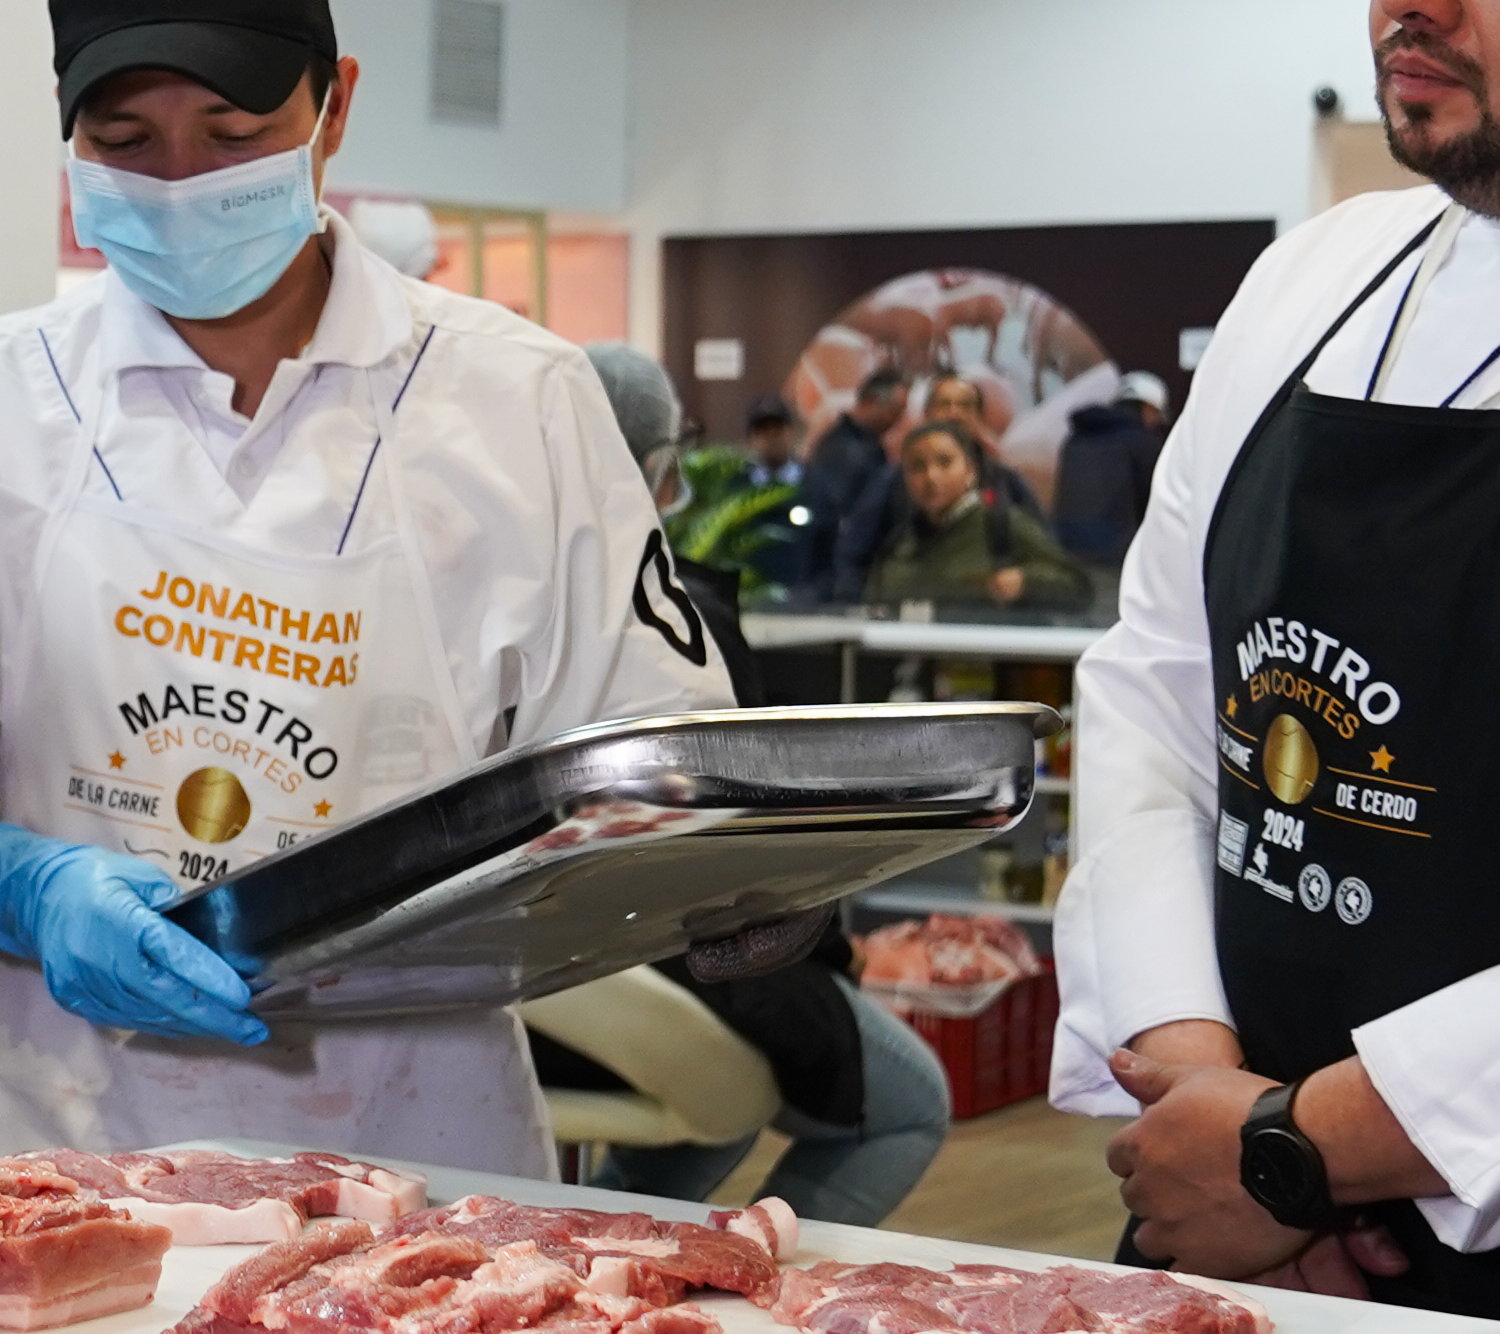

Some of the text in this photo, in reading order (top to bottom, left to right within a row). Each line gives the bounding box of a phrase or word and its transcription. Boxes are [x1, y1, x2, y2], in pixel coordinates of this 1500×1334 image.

[140, 570, 364, 645] JONATHAN
[113, 605, 361, 689] CONTRERAS
[1236, 617, 1401, 726] MAESTRO
[118, 684, 339, 782] MAESTRO
[1250, 668, 1361, 740] EN CORTES
[145, 725, 304, 795] EN CORTES
[68, 776, 161, 818] DE LA CARNE
[1261, 808, 1305, 853] 2024
[1336, 782, 1418, 822] DE CERDO
[179, 850, 230, 882] 2024
